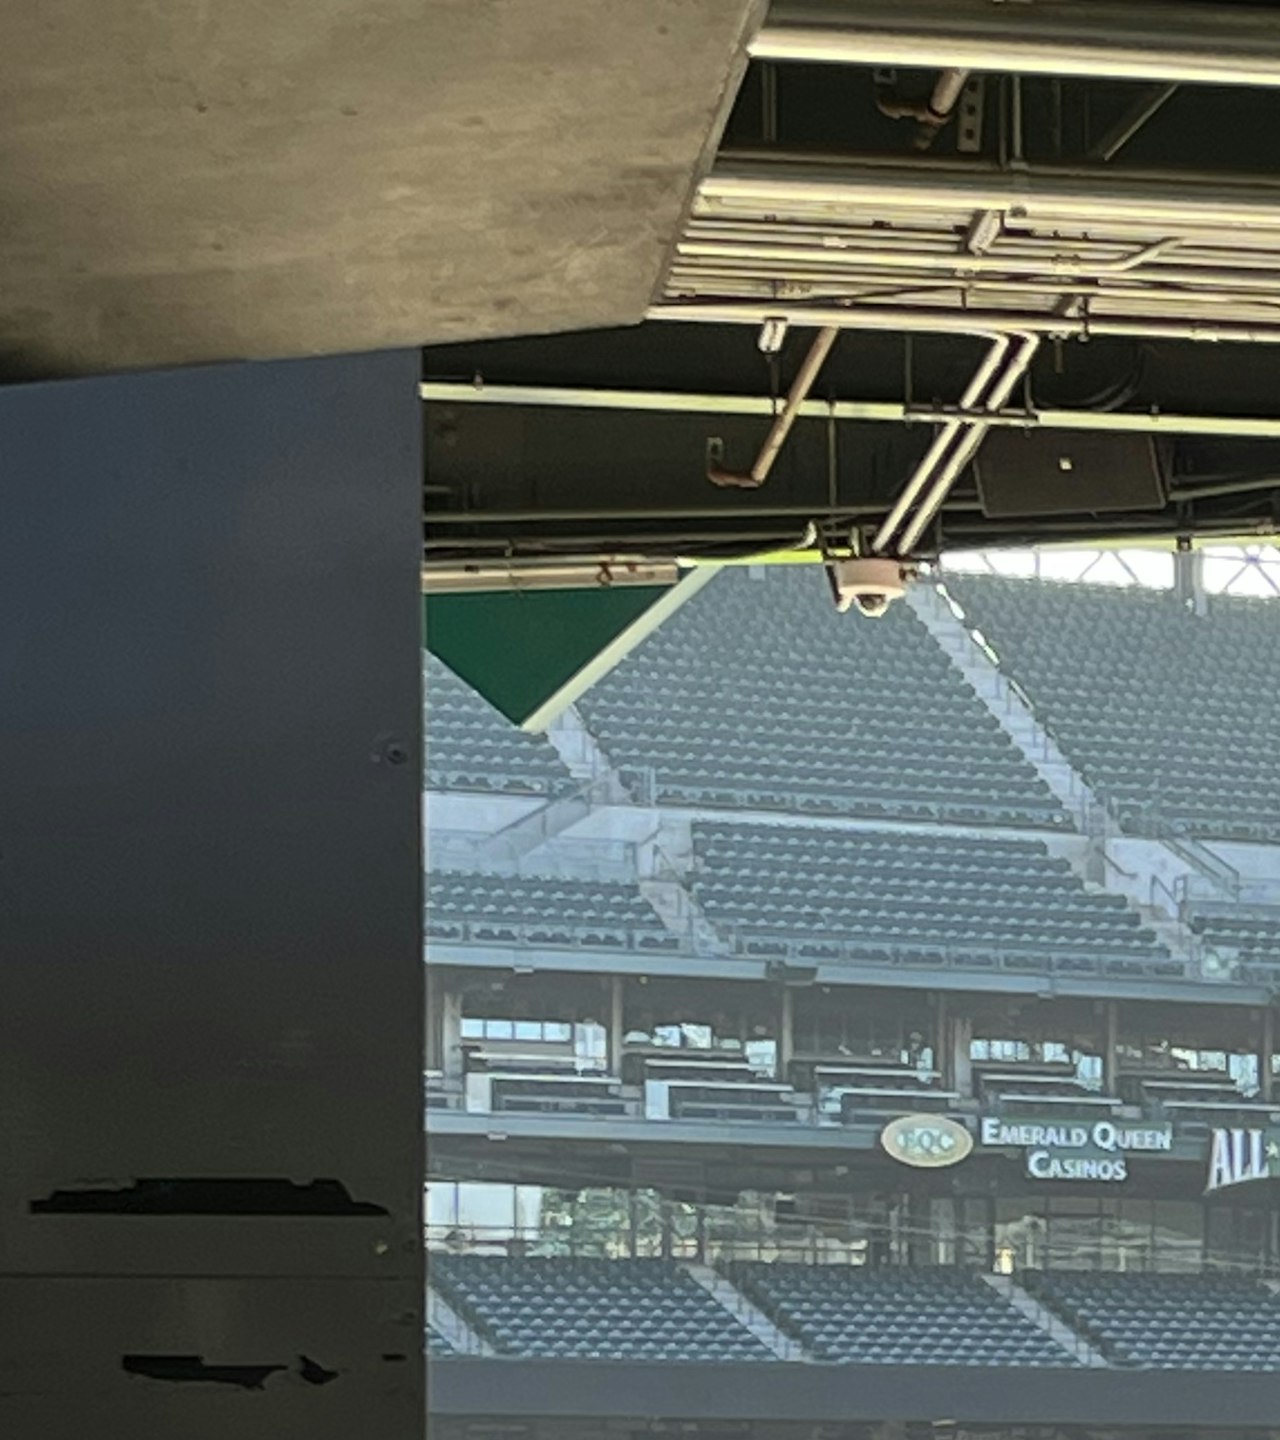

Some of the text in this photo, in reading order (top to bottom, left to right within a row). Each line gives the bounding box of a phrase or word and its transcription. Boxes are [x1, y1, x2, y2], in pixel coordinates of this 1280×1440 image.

[981, 1118, 1172, 1151] EMERALD QUEEN
[1028, 1150, 1128, 1180] CASINOS
[1205, 1128, 1270, 1193] ALL
